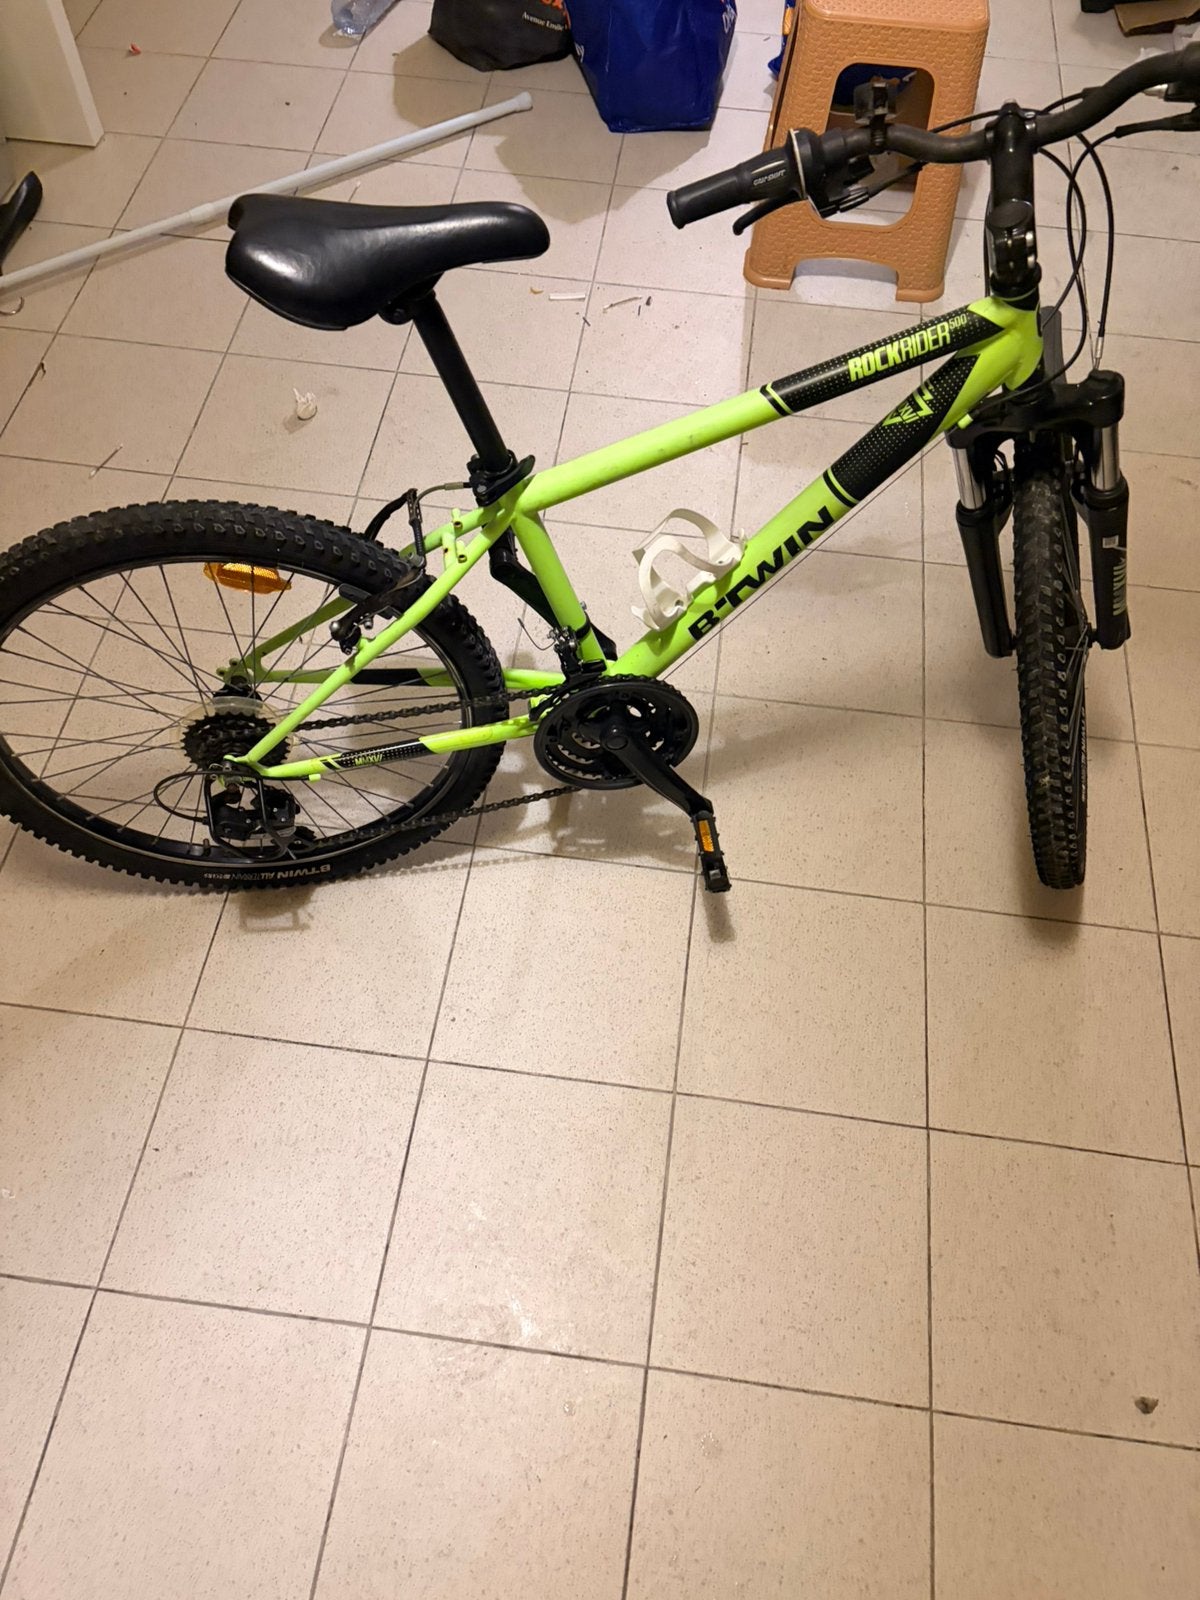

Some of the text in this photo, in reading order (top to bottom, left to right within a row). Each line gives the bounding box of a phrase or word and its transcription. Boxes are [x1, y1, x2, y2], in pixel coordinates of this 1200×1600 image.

[522, 11, 545, 27] Avenue
[847, 313, 968, 382] ROCKRIDER 500
[276, 863, 332, 880] BTWIN
